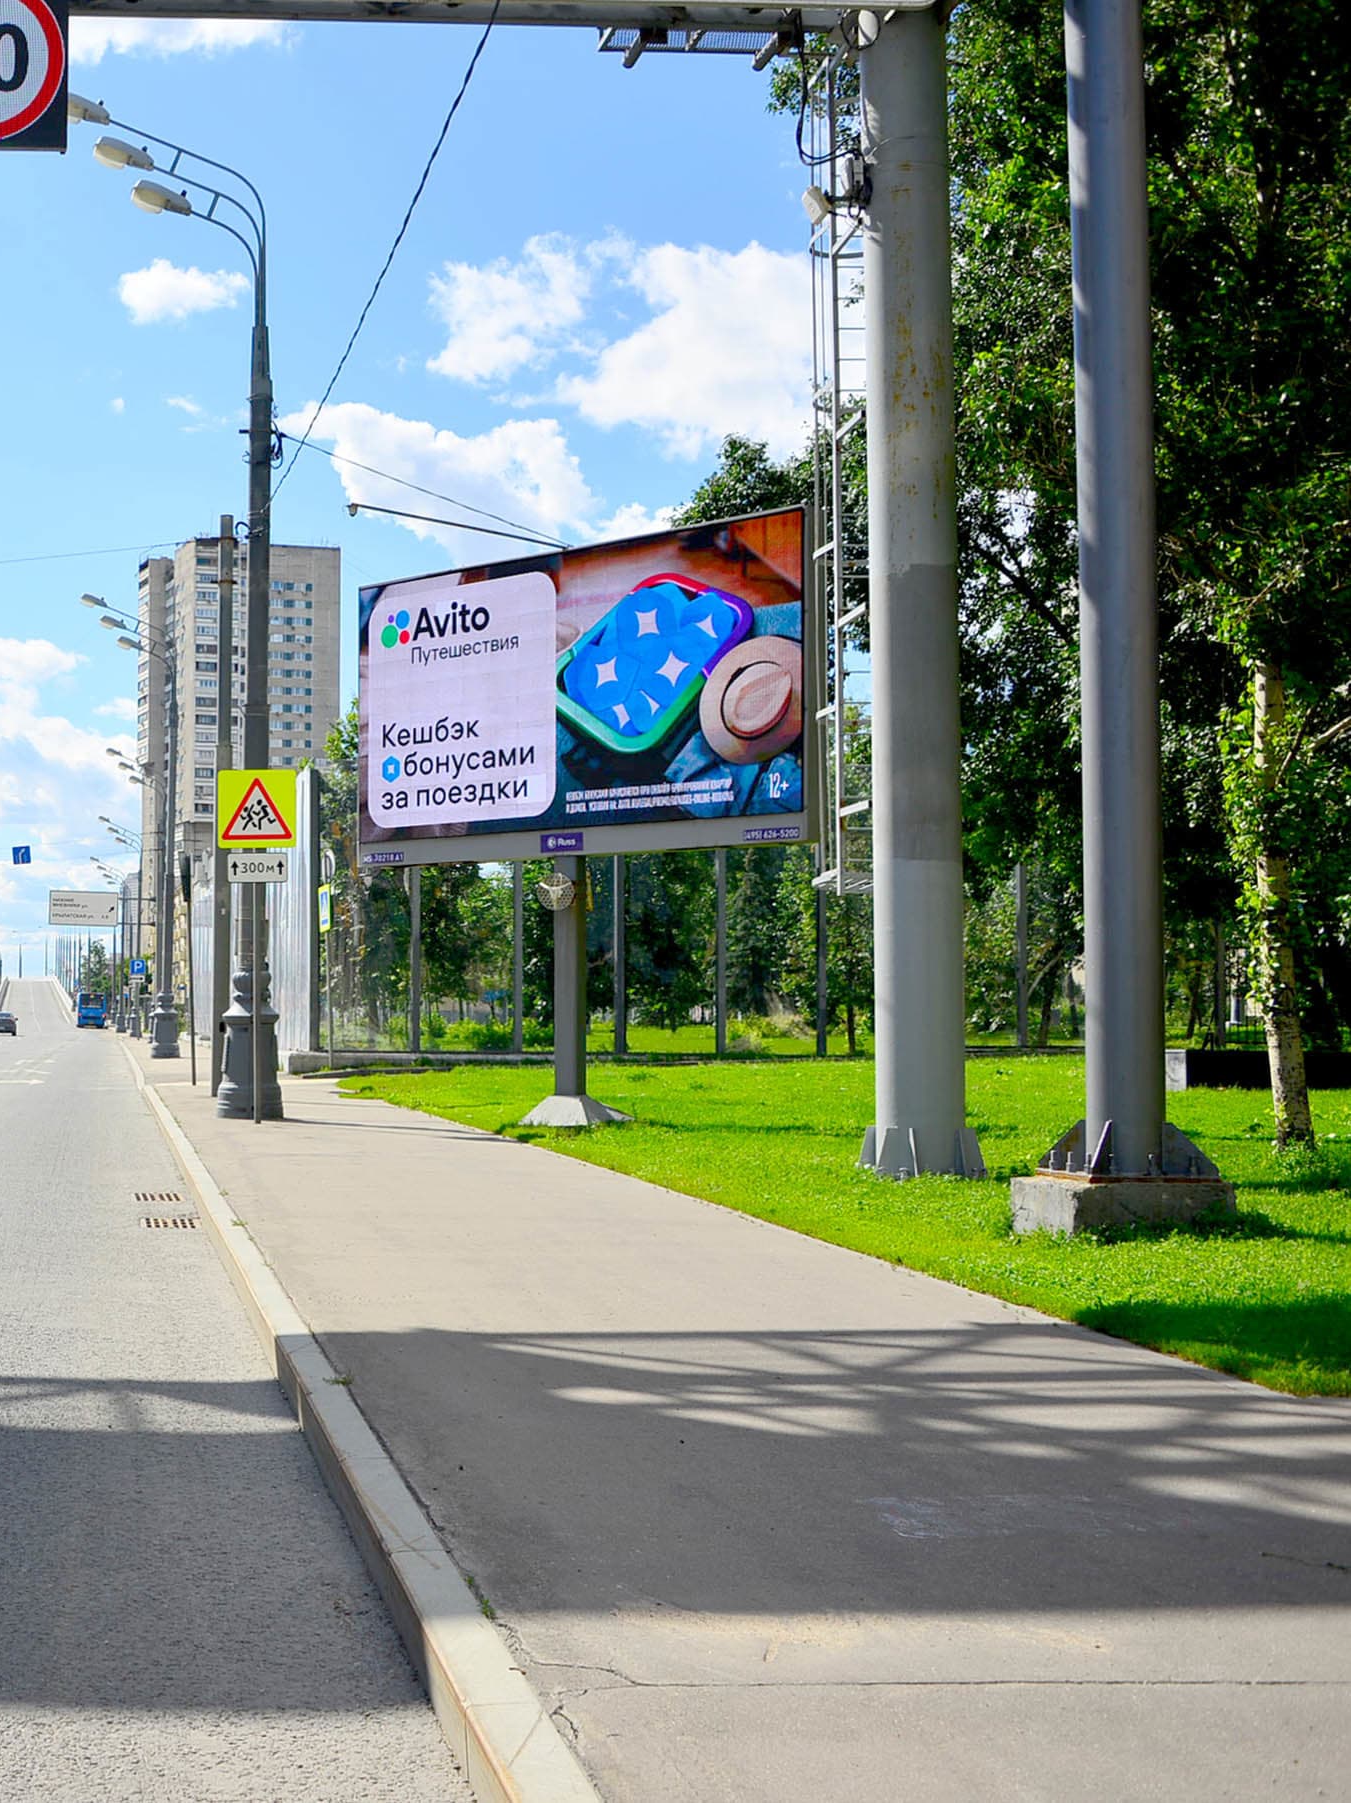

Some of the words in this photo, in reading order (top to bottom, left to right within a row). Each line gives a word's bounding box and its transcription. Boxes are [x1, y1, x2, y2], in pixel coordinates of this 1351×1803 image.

[412, 601, 490, 642] Avito
[411, 635, 520, 667] Путешествия
[382, 716, 480, 749] Кешбэк
[403, 744, 535, 780] бонусами
[381, 790, 409, 811] за
[416, 778, 528, 808] поездки
[768, 771, 790, 799] 12+
[241, 862, 275, 874] 300м
